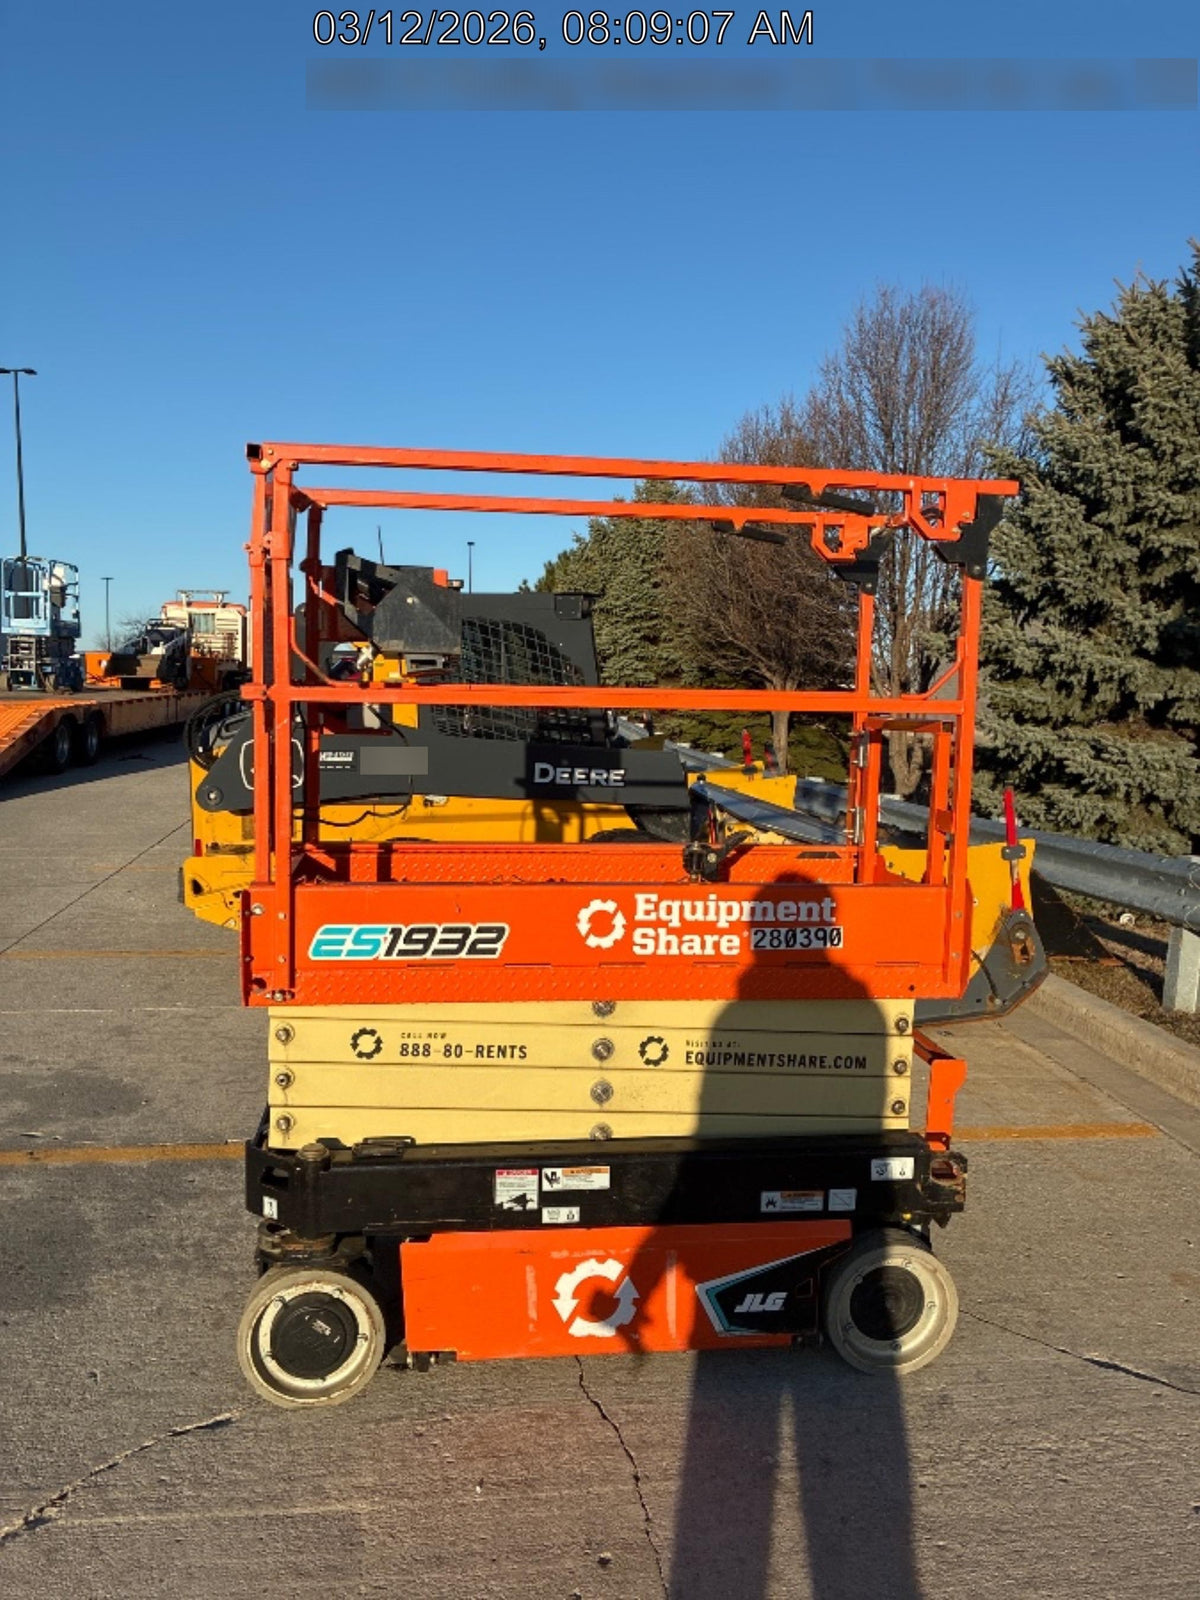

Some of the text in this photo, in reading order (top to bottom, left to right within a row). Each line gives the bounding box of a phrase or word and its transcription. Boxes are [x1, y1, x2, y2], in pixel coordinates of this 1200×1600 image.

[634, 893, 837, 928] Equipment
[310, 924, 508, 959] ES1932
[632, 927, 741, 956] Share
[752, 927, 842, 949] 280390
[399, 1043, 527, 1059] 888-80-RENTS
[685, 1051, 867, 1069] EQUIPMENTSHARE.COM
[734, 1291, 788, 1313] JLG
